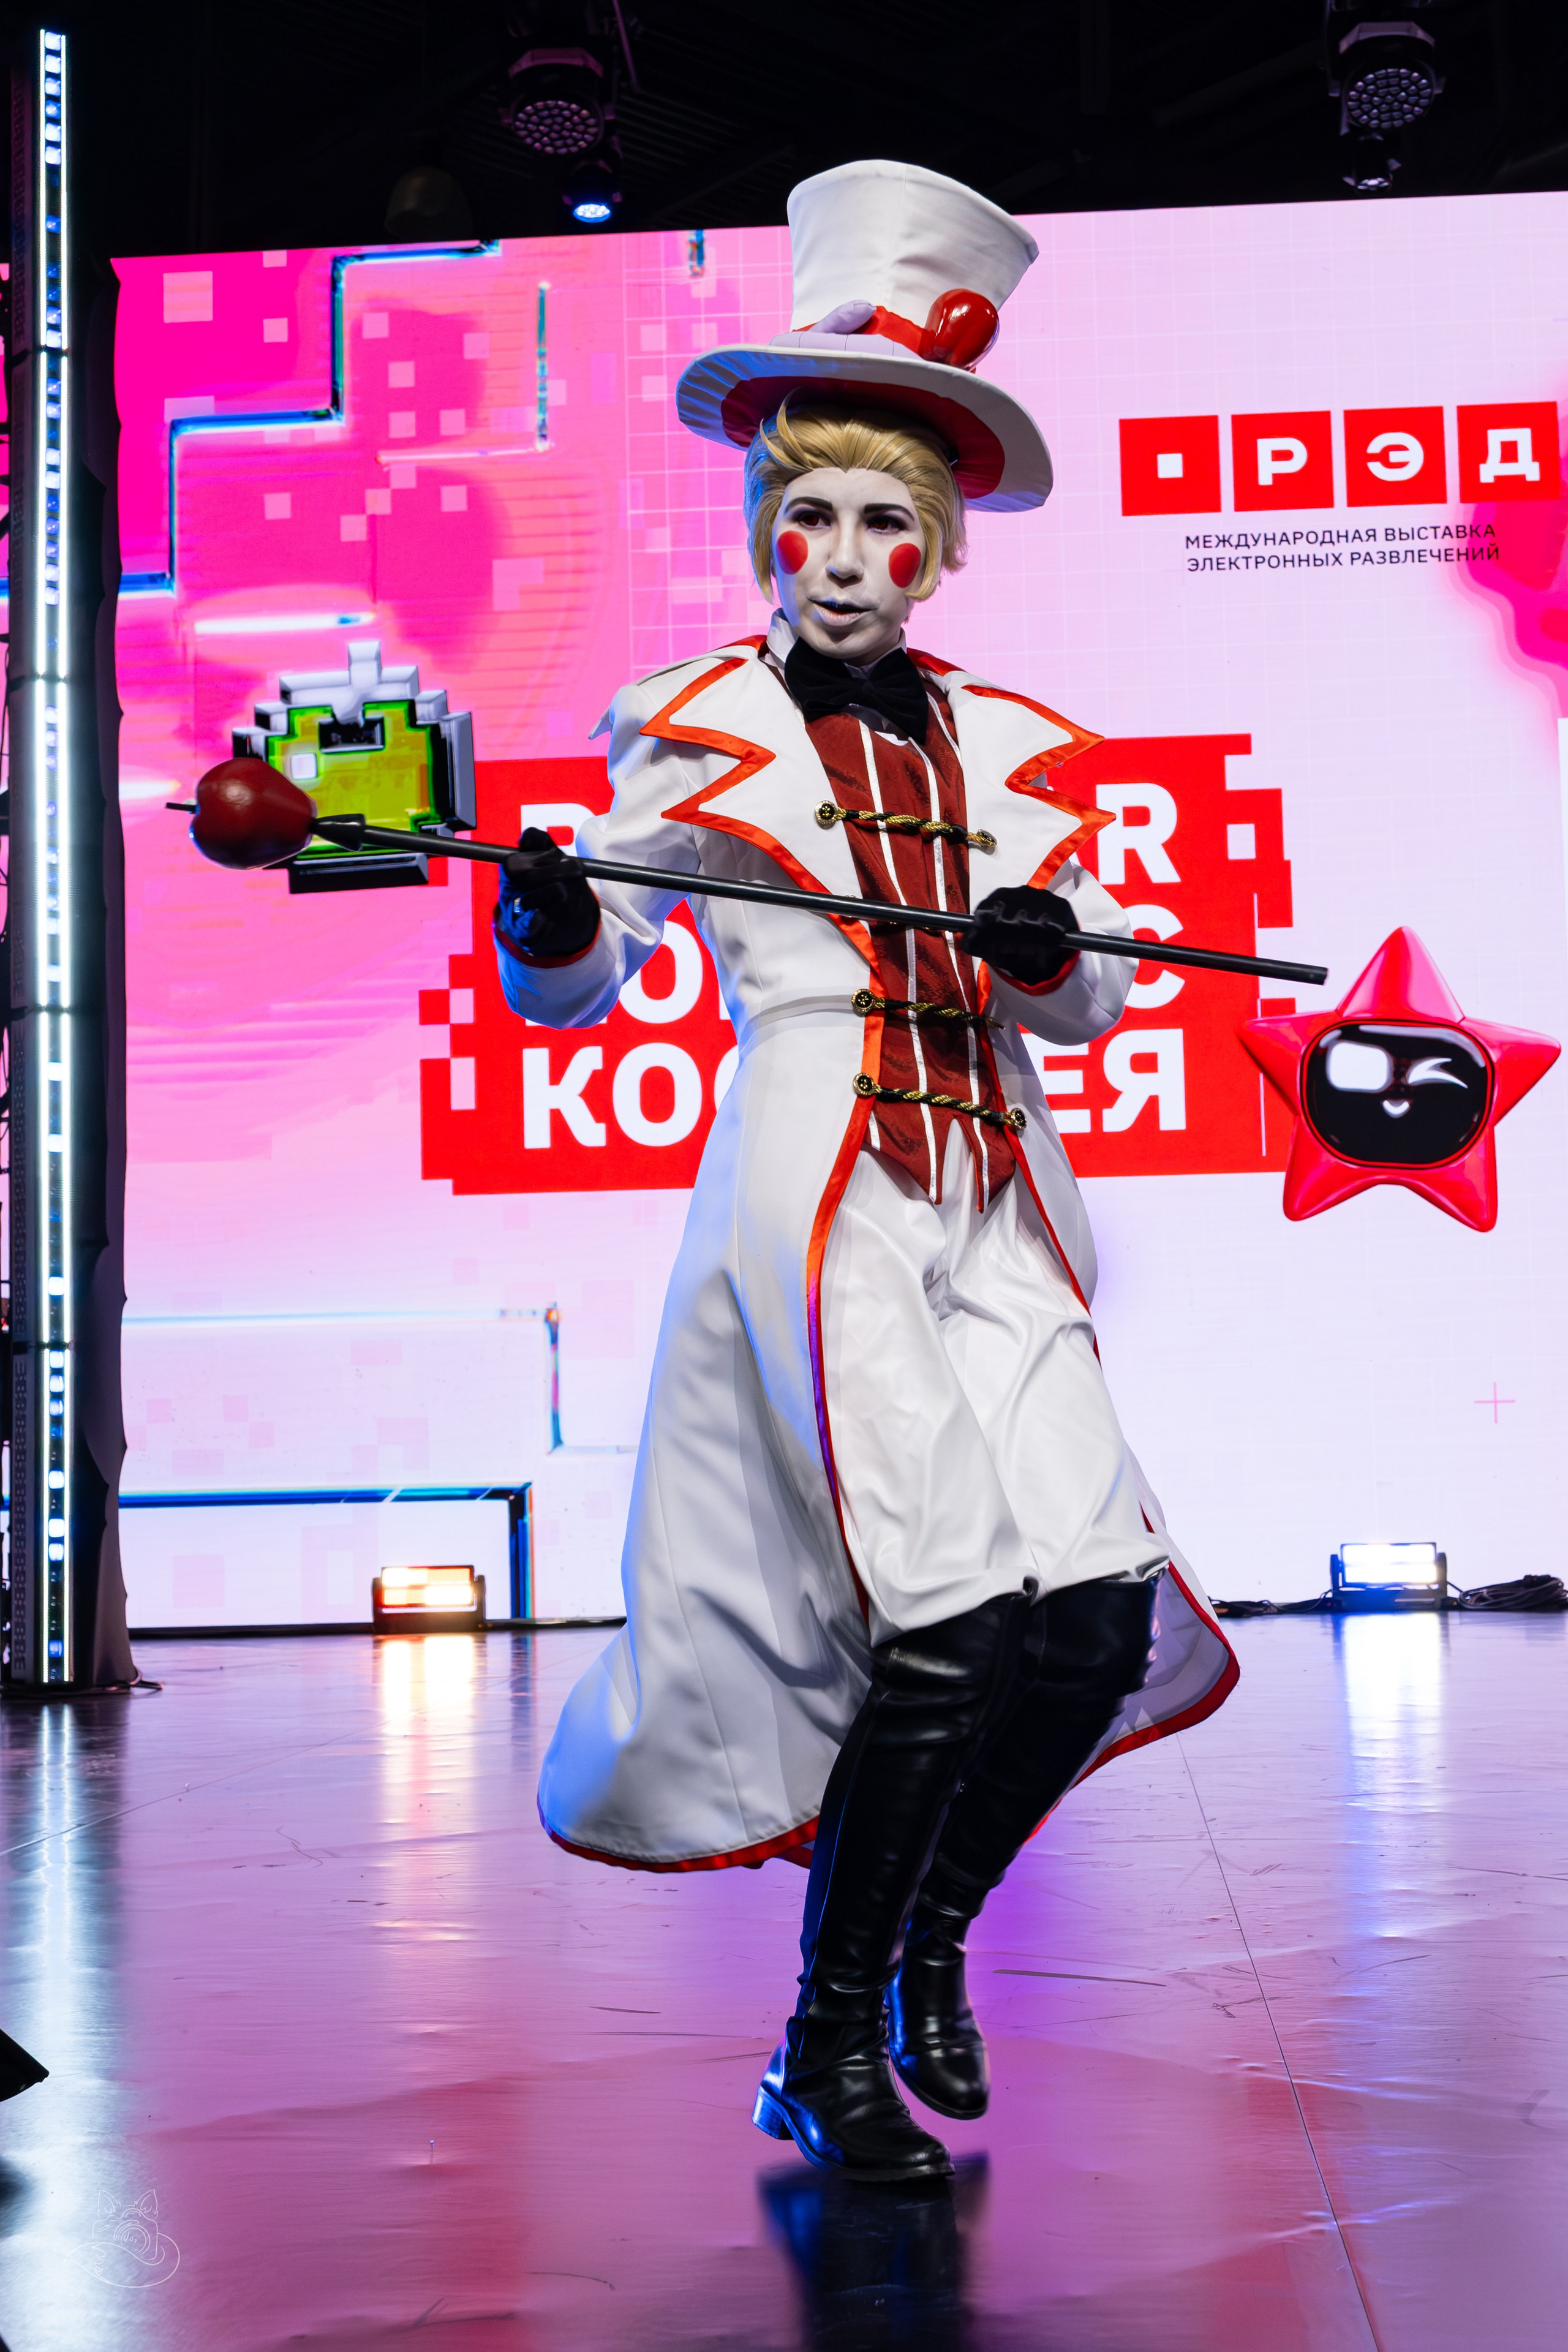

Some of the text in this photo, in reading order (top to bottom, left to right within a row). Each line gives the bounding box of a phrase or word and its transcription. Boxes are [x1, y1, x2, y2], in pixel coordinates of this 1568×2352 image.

[1257, 428, 1540, 486] РЭД
[1185, 524, 1496, 550] МЕЖДУНАРОДНАЯ ВЫСТАВКА
[1187, 543, 1499, 572] ЭЛЕКТРОННЫХ РАЗВЛЕЧЕНИЙ
